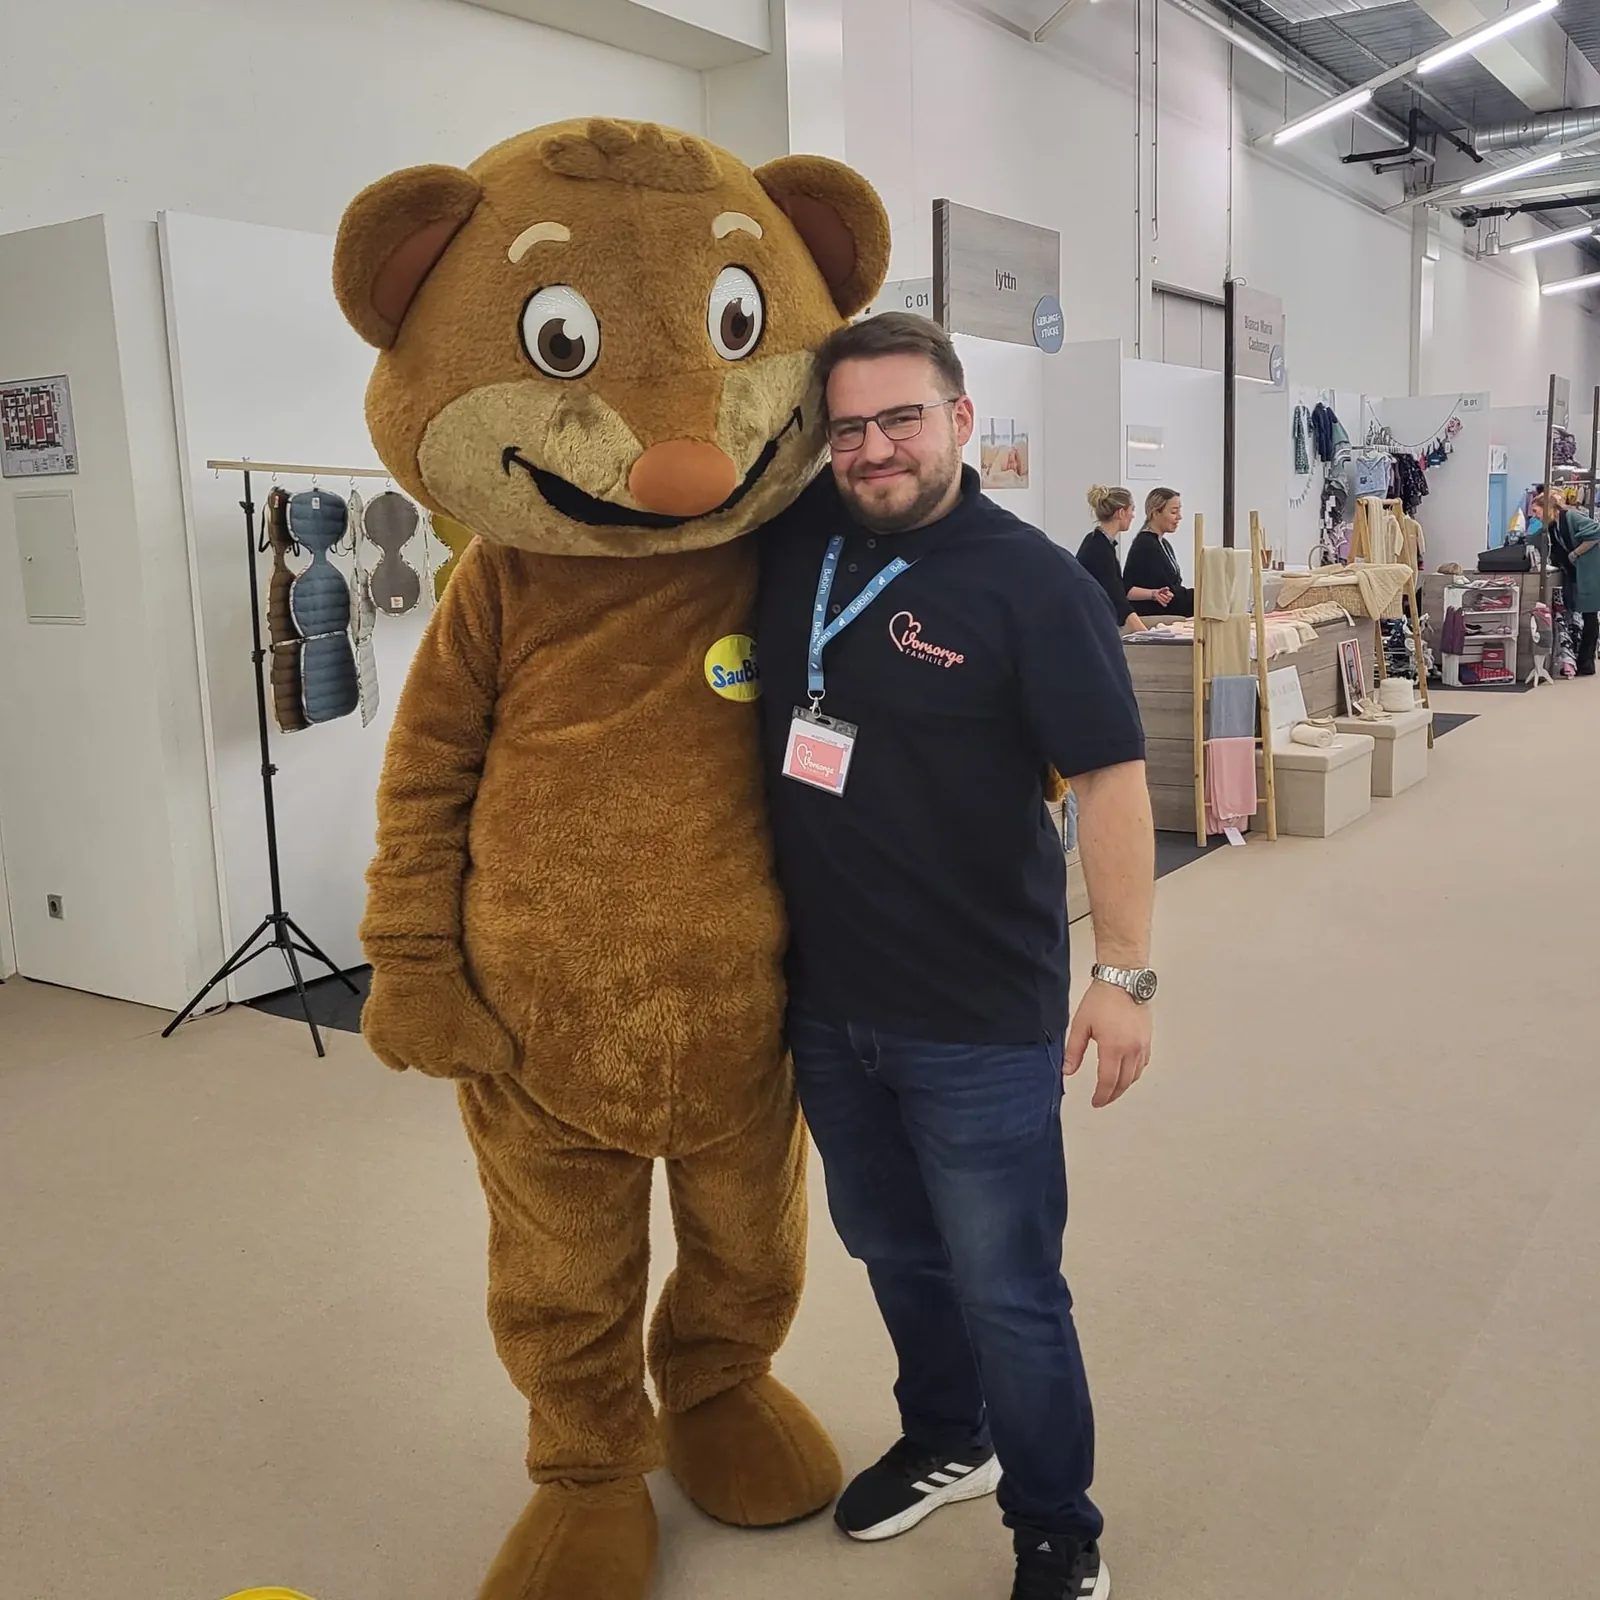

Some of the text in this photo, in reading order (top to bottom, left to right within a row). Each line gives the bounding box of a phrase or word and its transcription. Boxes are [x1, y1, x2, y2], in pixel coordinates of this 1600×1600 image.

[995, 269, 1017, 291] lyttn
[905, 293, 929, 309] C 01
[820, 568, 833, 595] Babini
[850, 590, 874, 614] Babini
[901, 630, 964, 668] Vorsorge
[905, 648, 943, 666] FAMILIE
